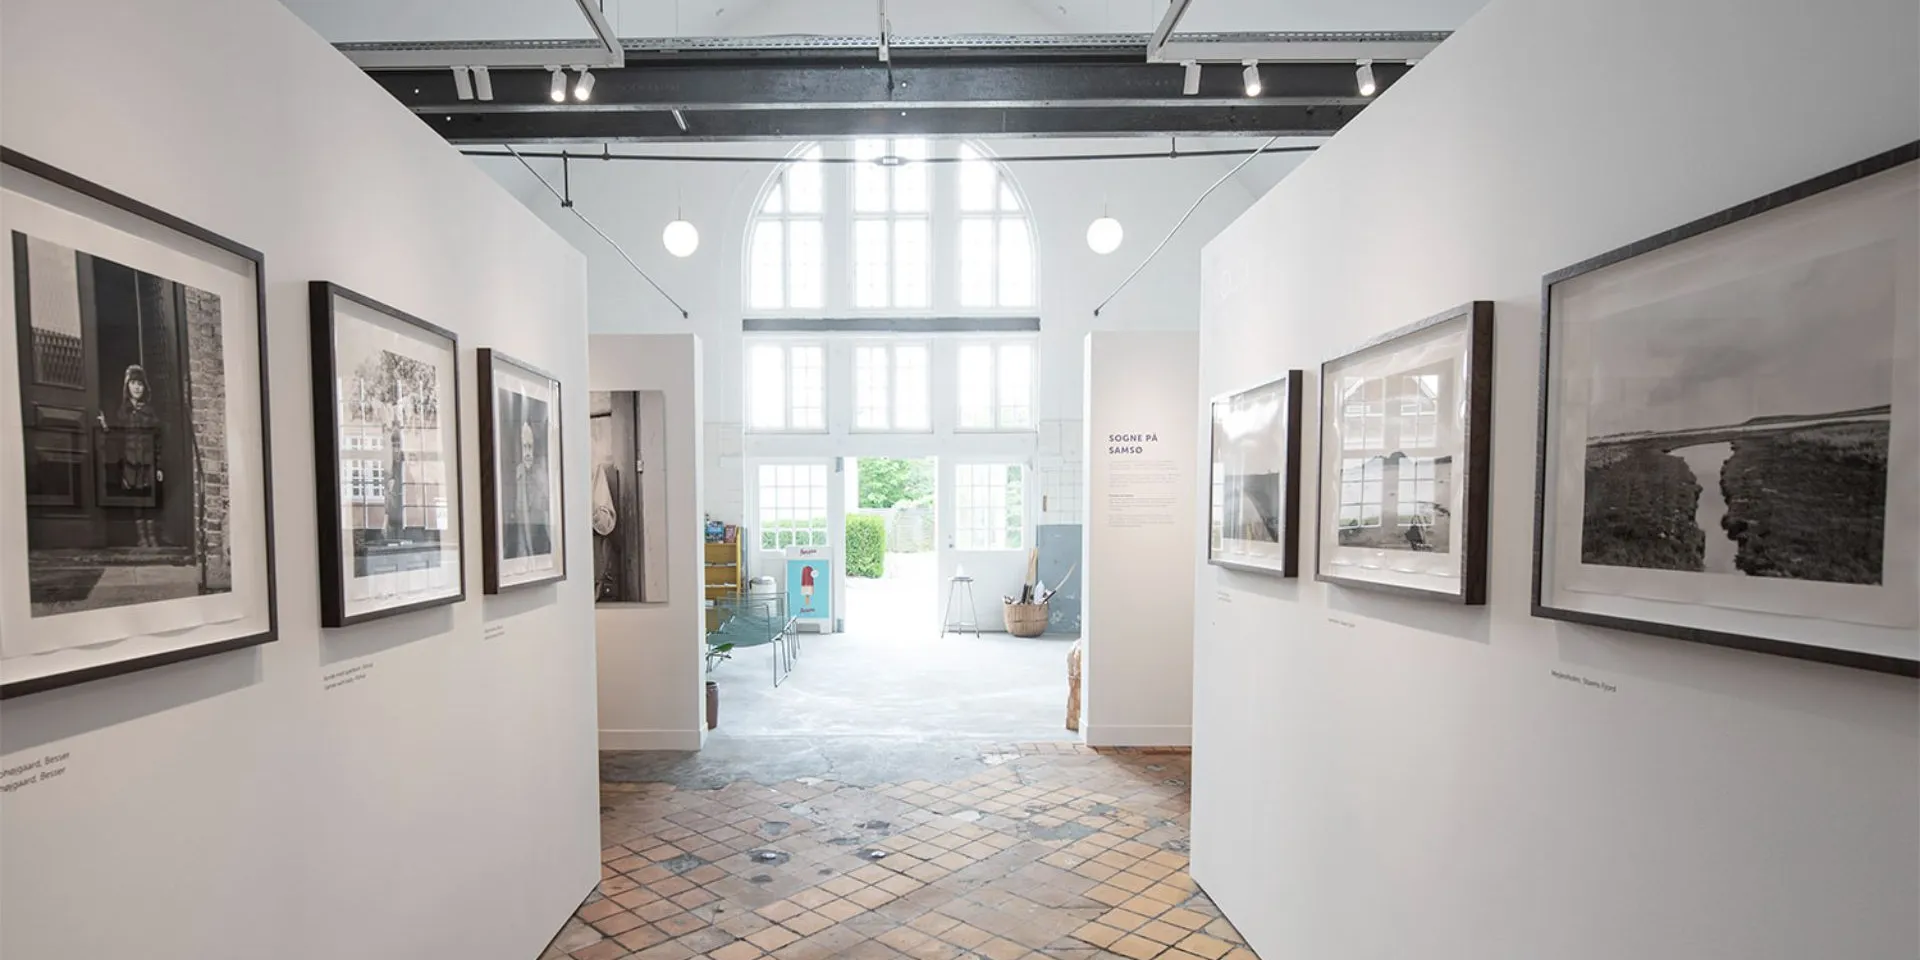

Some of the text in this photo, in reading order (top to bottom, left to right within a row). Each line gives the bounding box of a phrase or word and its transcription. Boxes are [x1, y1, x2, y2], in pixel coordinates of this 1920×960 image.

[1109, 432, 1158, 442] SOGNE PÅ
[45, 752, 70, 765] Besser
